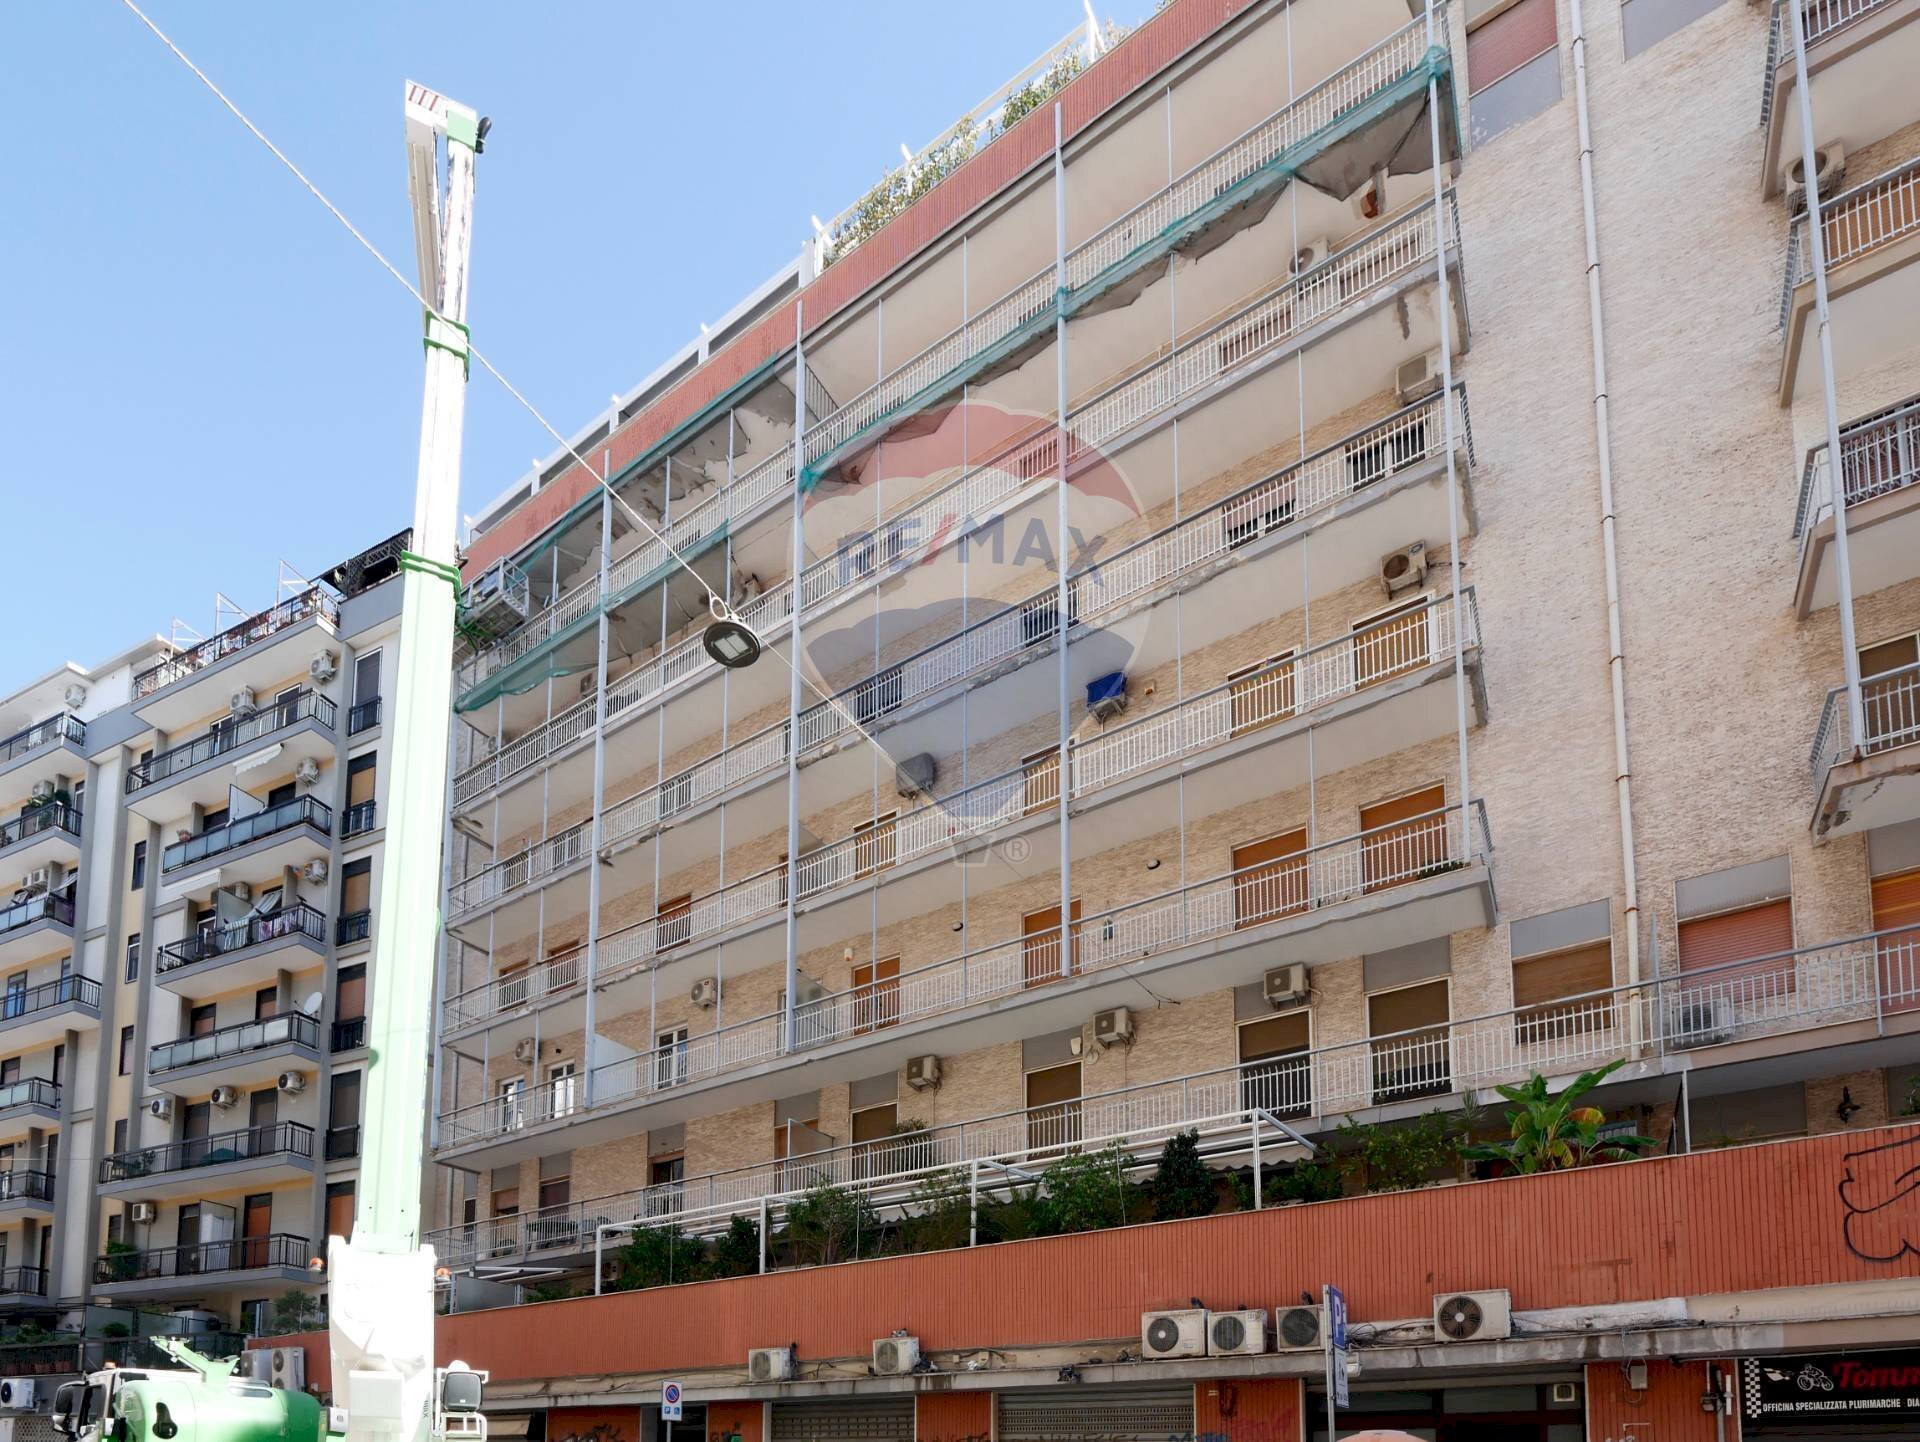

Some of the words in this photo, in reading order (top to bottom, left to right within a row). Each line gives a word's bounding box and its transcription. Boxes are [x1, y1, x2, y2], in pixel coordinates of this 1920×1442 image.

[1763, 1402, 1794, 1412] OFFICINA
[1795, 1400, 1847, 1411] SPECIALIZZATA
[1849, 1399, 1901, 1409] PLURIMARCHE
